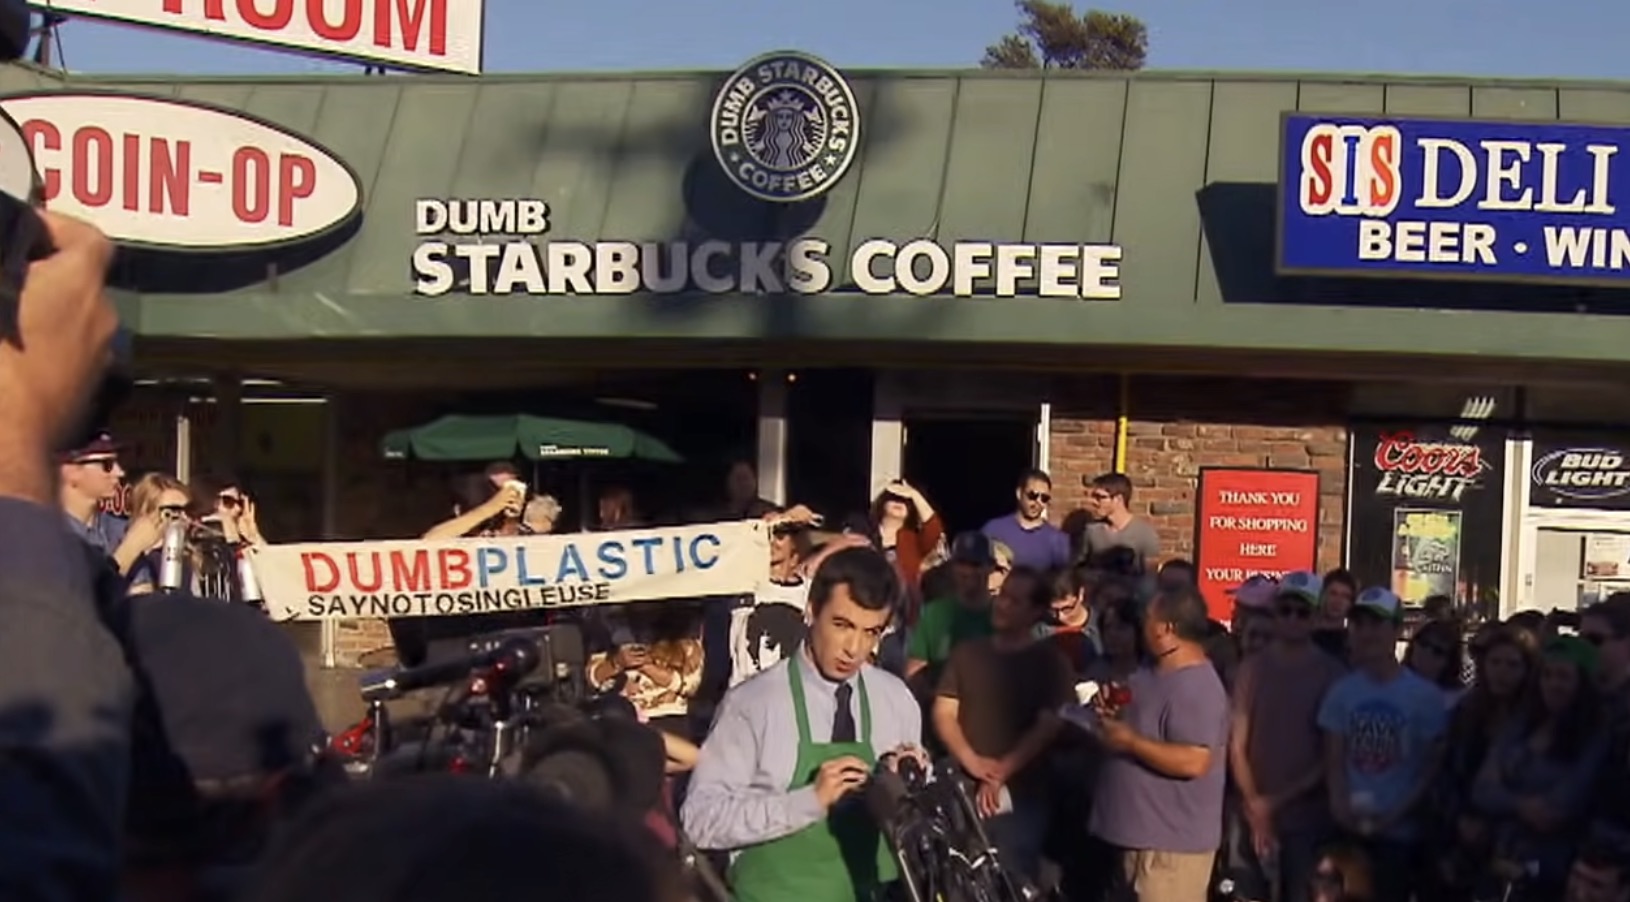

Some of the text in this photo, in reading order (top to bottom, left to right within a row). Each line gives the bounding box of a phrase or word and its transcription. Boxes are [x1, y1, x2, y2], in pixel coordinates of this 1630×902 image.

[720, 60, 850, 152] DUMB STARBUCKS
[21, 118, 316, 227] COIN-OP
[738, 162, 828, 193] COFFEE
[1304, 129, 1618, 214] SIS DELI
[416, 199, 547, 233] DUMB
[1358, 219, 1498, 264] BEER
[413, 239, 1122, 299] STARBUCKS COFFEE
[1374, 431, 1483, 478] Coors
[1561, 453, 1623, 469] BUD
[1544, 470, 1630, 487] LIGHT
[1218, 490, 1301, 506] THANK YOU
[1209, 516, 1308, 532] FOR SHOPPING
[1239, 543, 1277, 557] HERE
[1206, 567, 1243, 581] YOUR
